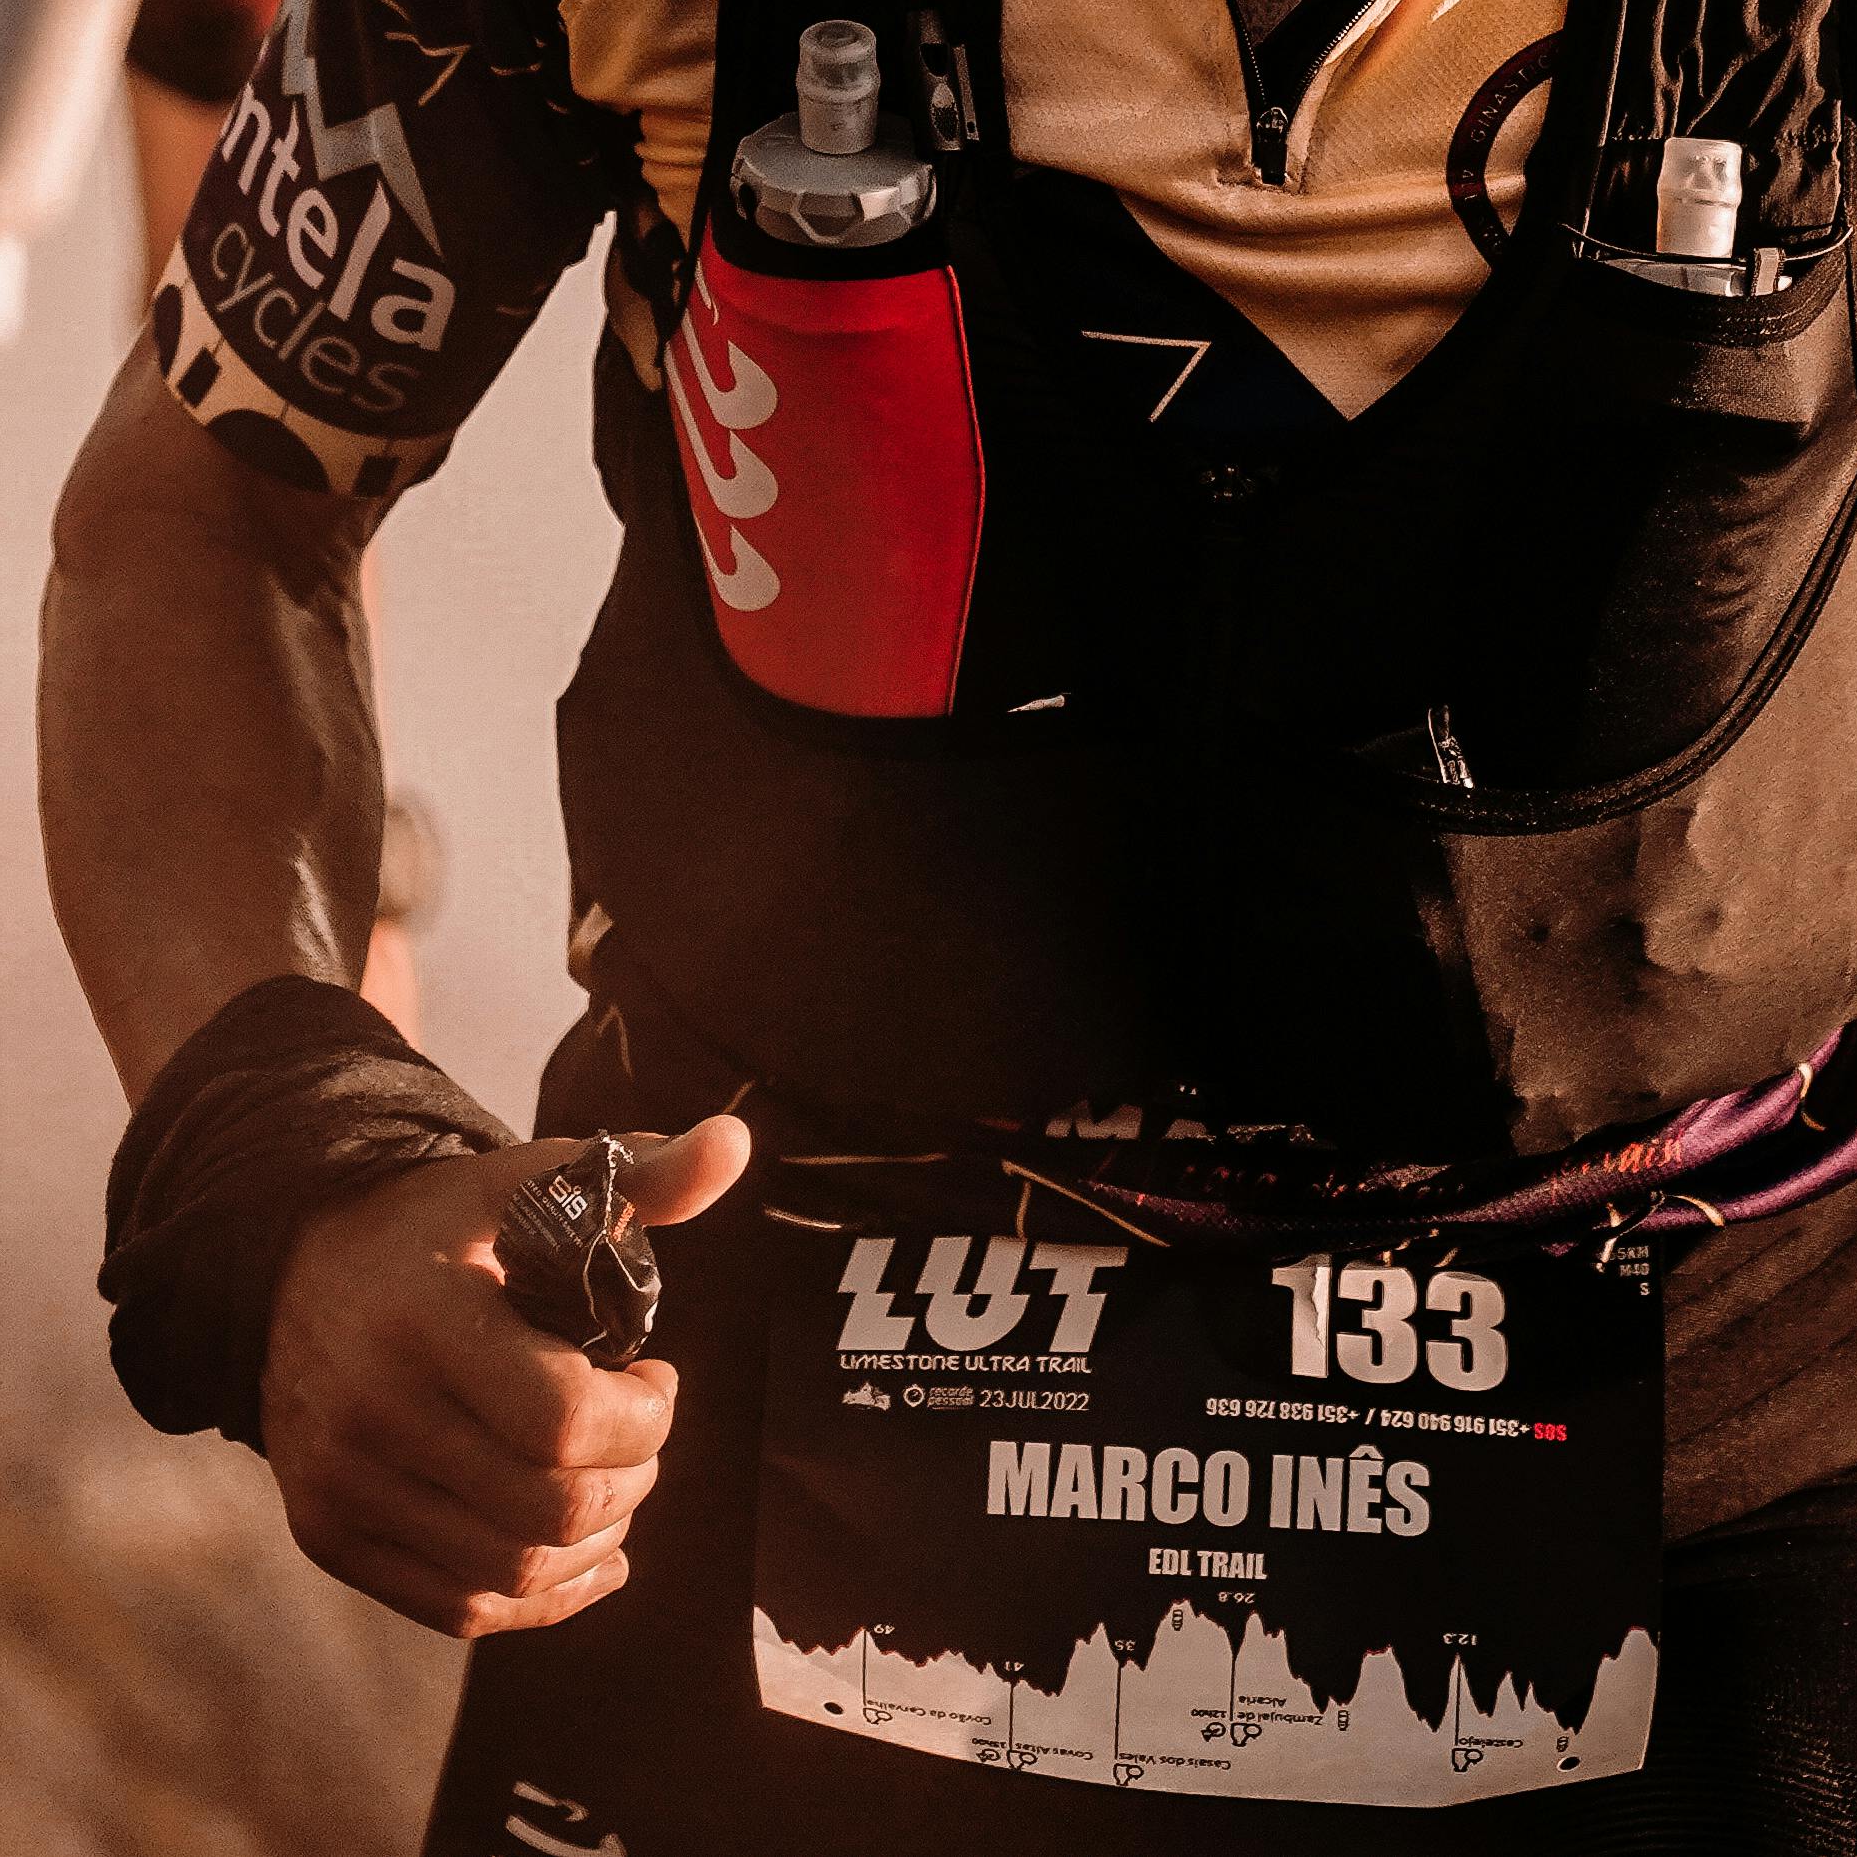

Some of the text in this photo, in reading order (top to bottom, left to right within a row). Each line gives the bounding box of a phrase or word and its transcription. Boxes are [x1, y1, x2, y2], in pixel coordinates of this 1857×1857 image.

[223, 81, 456, 352] ntela
[212, 223, 421, 412] cycles
[836, 1235, 1131, 1352] LUT
[1270, 1254, 1508, 1392] 133
[840, 1354, 1092, 1374] LIMESTONE ULTRA TRAIL
[1205, 1397, 1240, 1418] 636
[1245, 1399, 1276, 1419] 726
[1279, 1401, 1314, 1421] 938
[1317, 1404, 1359, 1424] +351
[1380, 1410, 1414, 1430] 624
[1418, 1412, 1451, 1432] 940
[1453, 1415, 1486, 1435] 916
[1489, 1418, 1531, 1436] +351
[986, 1440, 1431, 1537] MARCO INÊS
[1148, 1548, 1267, 1580] EDL TRAIL
[1217, 1591, 1255, 1603] 26.8
[873, 1623, 895, 1635] 49
[1442, 1633, 1478, 1645] 12.3
[1114, 1639, 1136, 1651] 35
[1004, 1660, 1025, 1672] 41
[1238, 1695, 1286, 1708] Alcaria
[1237, 1711, 1323, 1726] Zambujal de
[1158, 1754, 1185, 1768] dos
[1187, 1756, 1231, 1771] Casais
